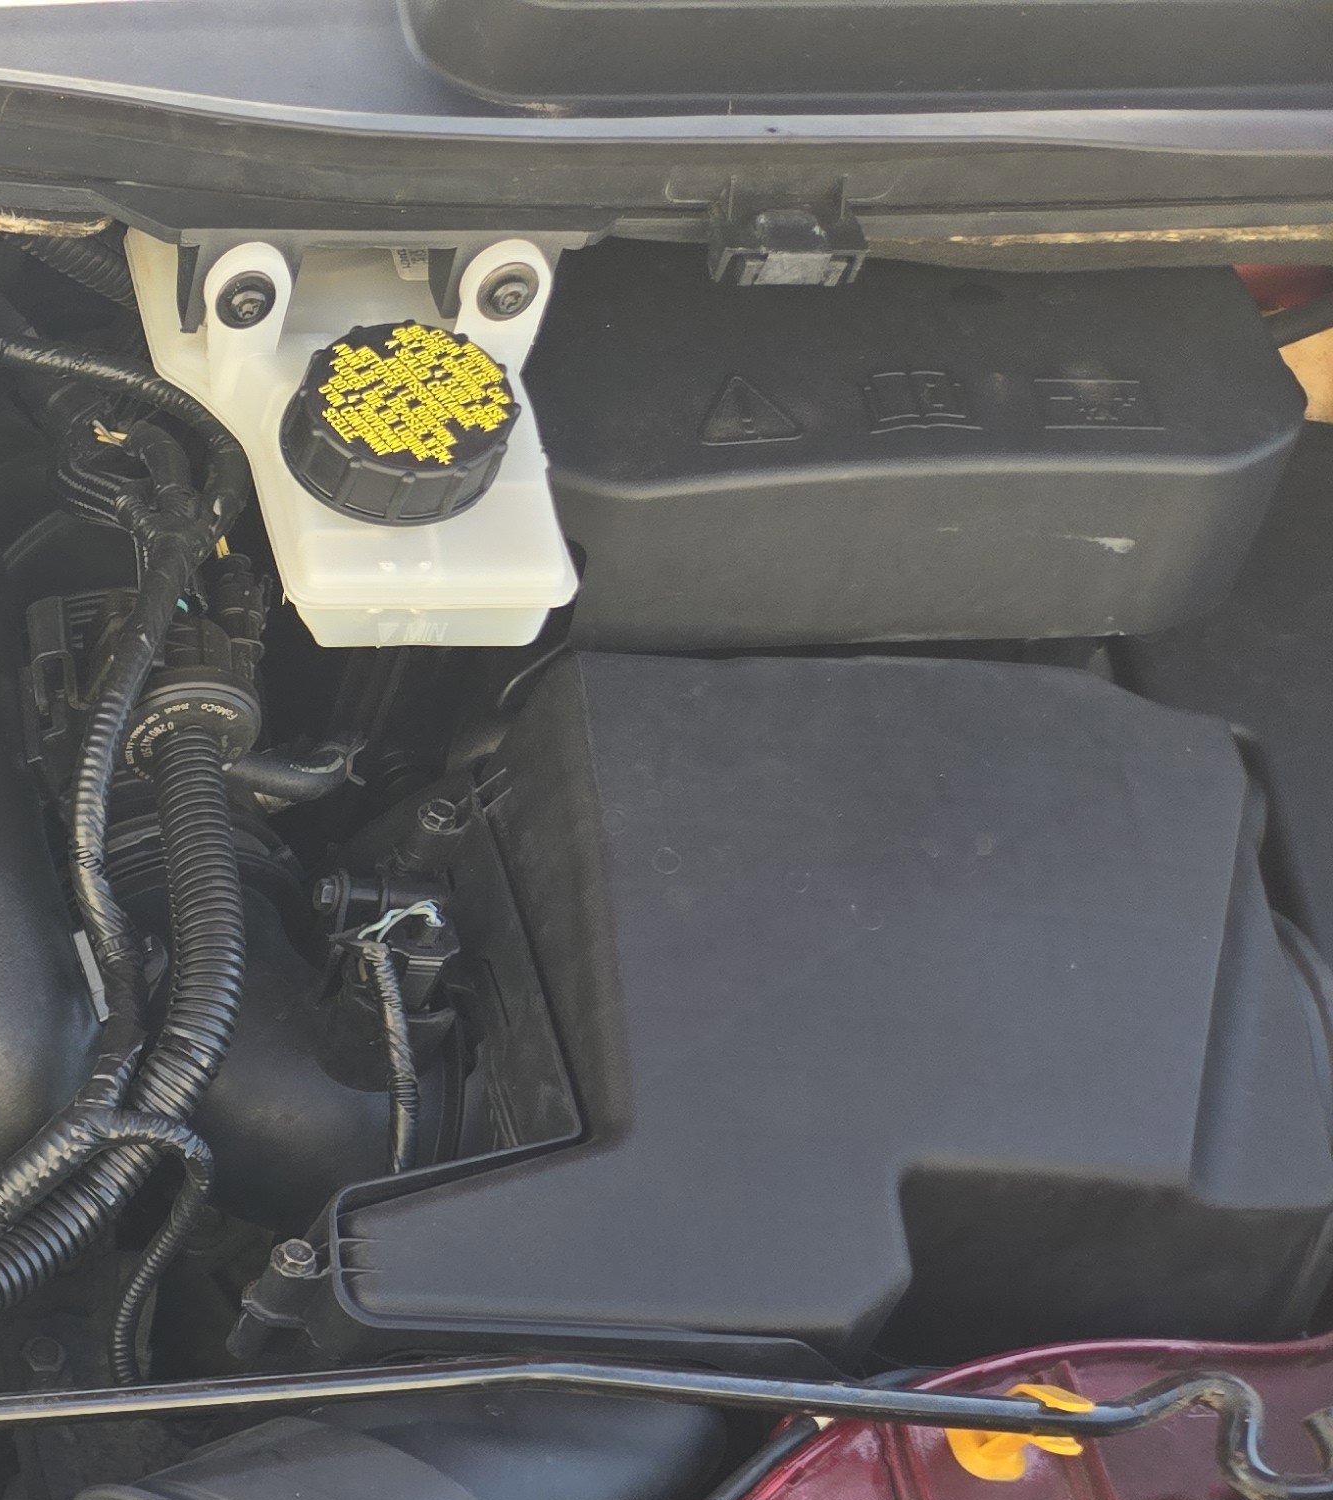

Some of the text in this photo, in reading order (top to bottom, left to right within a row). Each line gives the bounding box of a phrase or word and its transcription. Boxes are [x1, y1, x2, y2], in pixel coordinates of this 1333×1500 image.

[332, 343, 367, 371] AVANT
[359, 368, 379, 385] DE
[355, 346, 457, 448] NETTOYER LE BOUCHON
[391, 327, 421, 351] ONLY
[414, 350, 439, 369] DOT
[441, 377, 473, 406] FLUID
[466, 404, 499, 432] FROM
[394, 347, 432, 381] SEALED
[407, 324, 445, 358] BEFORE
[482, 402, 509, 425] USE
[429, 327, 511, 407] CLEAN FILLER CAP
[327, 374, 353, 395] DOT
[354, 402, 409, 453] PROVENANT
[328, 358, 432, 462] PLOYER QUE DU LIQUIDE
[339, 405, 393, 457] CONTENANT
[403, 620, 448, 642] MIN
